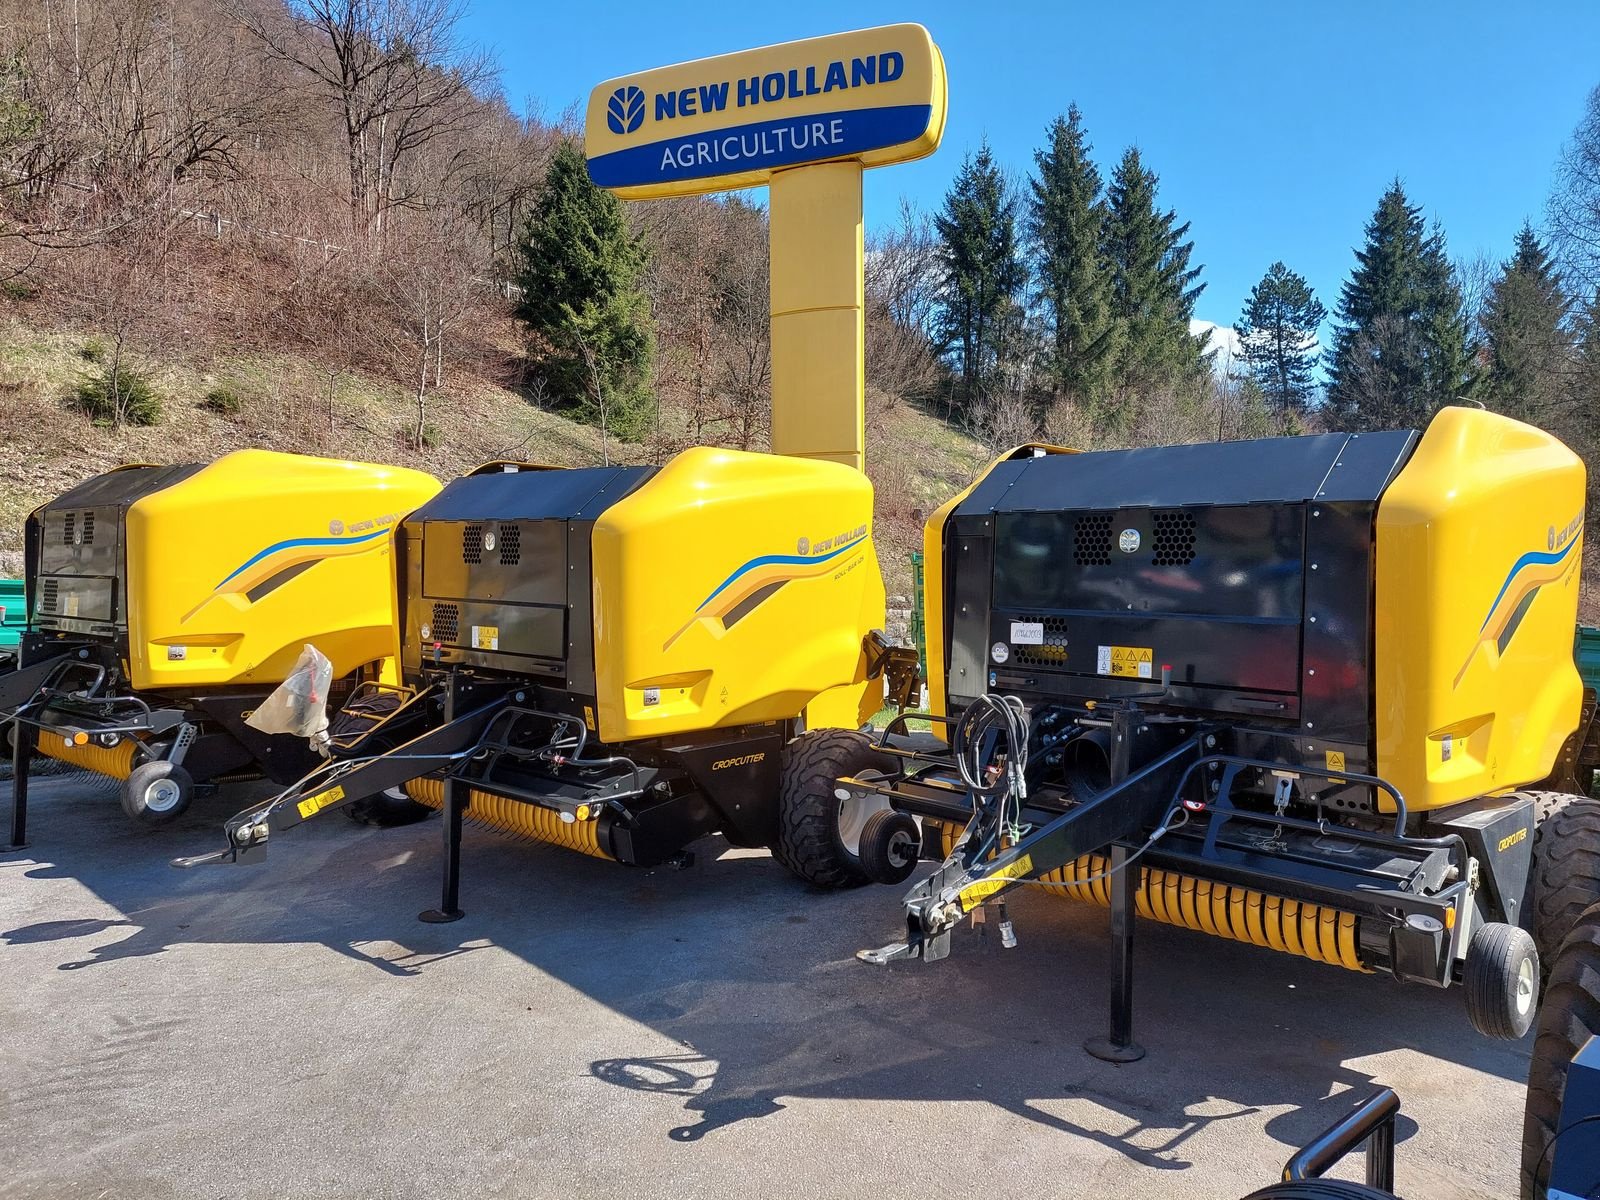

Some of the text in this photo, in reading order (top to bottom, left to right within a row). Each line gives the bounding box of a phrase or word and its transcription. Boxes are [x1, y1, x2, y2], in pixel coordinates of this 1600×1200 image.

[655, 51, 905, 121] NEW HOLLAND
[660, 119, 844, 171] AGRICULTURE
[348, 520, 374, 533] NEW
[813, 524, 867, 555] NEW HOLLAND
[1556, 526, 1568, 550] NEW
[712, 752, 765, 771] CROPCUTTER
